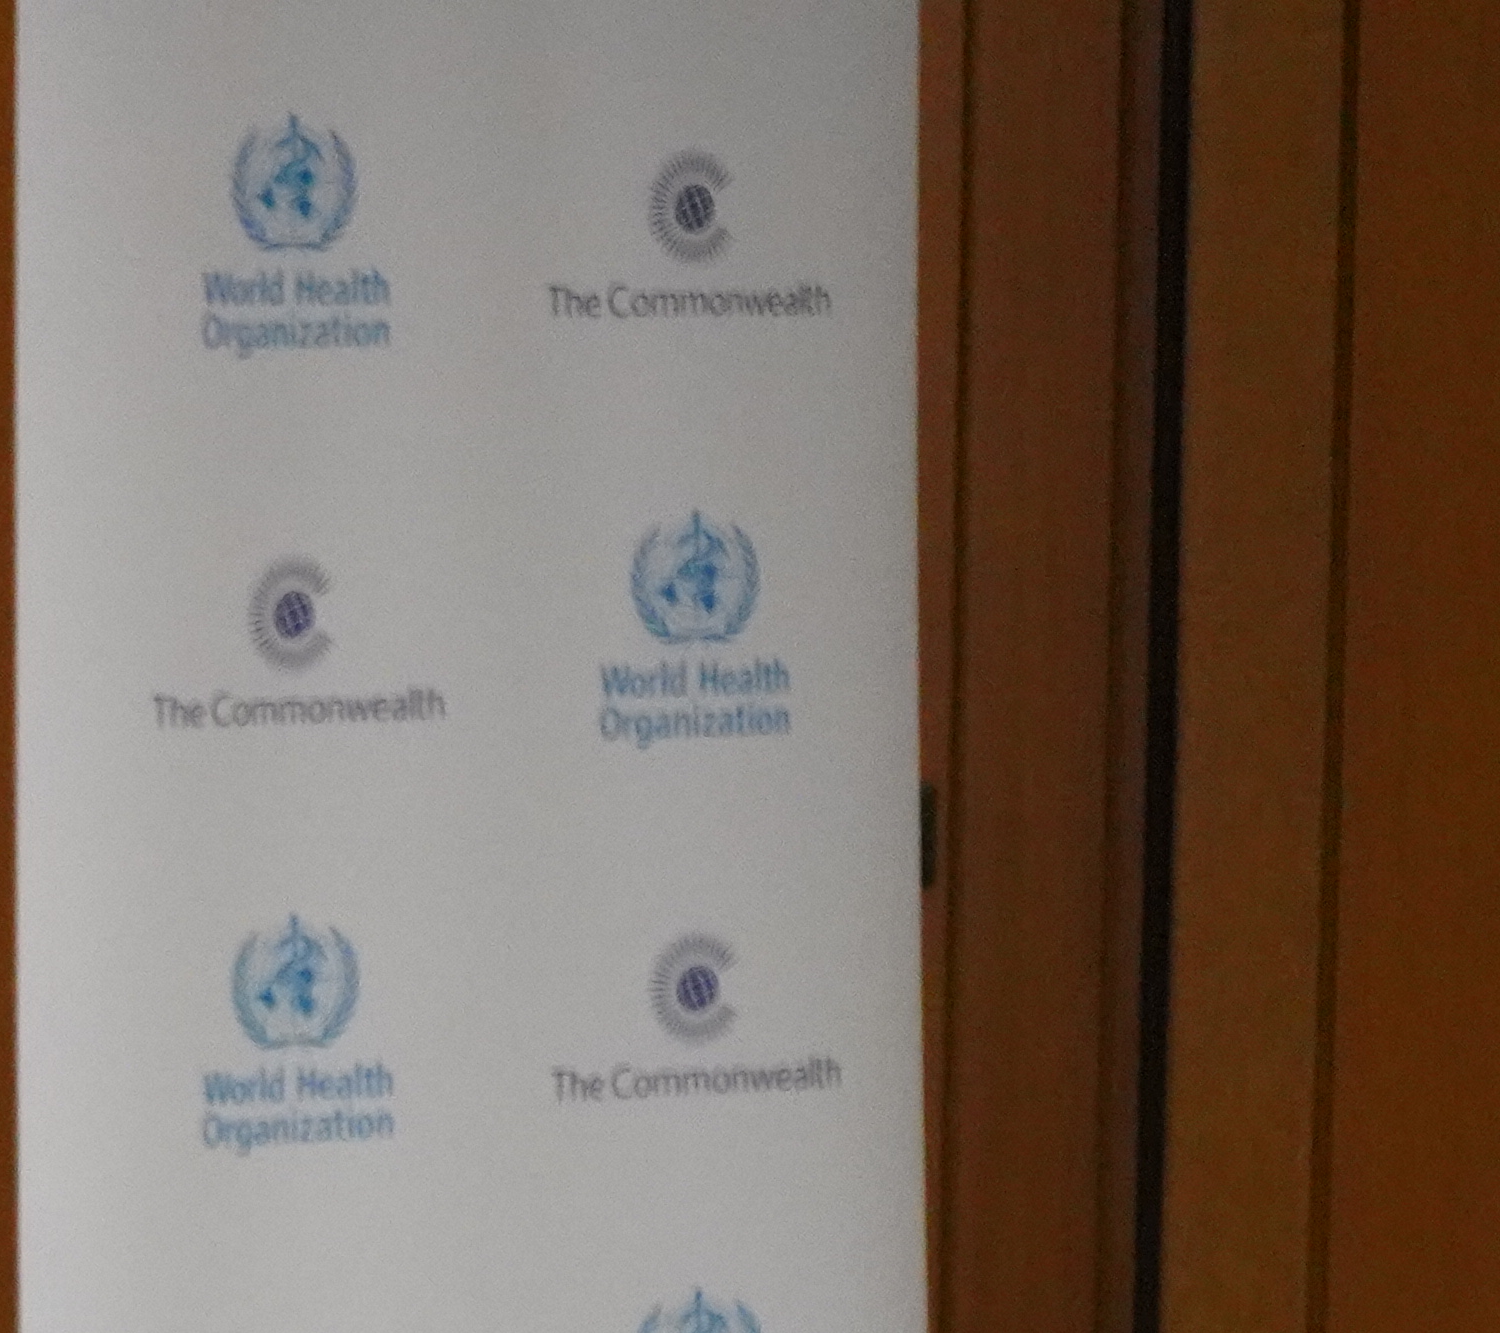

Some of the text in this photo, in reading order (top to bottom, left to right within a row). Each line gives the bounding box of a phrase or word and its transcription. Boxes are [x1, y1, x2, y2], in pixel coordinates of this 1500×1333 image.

[202, 266, 390, 306] World Health
[548, 279, 832, 318] The Commonwealth
[202, 314, 390, 359] Organization
[601, 658, 790, 697] World Health
[152, 685, 446, 729] The Commonwealth
[601, 706, 791, 750] Organization
[203, 1062, 394, 1105] World Health
[551, 1055, 843, 1102] The Commonwealth
[203, 1110, 394, 1157] Organization
